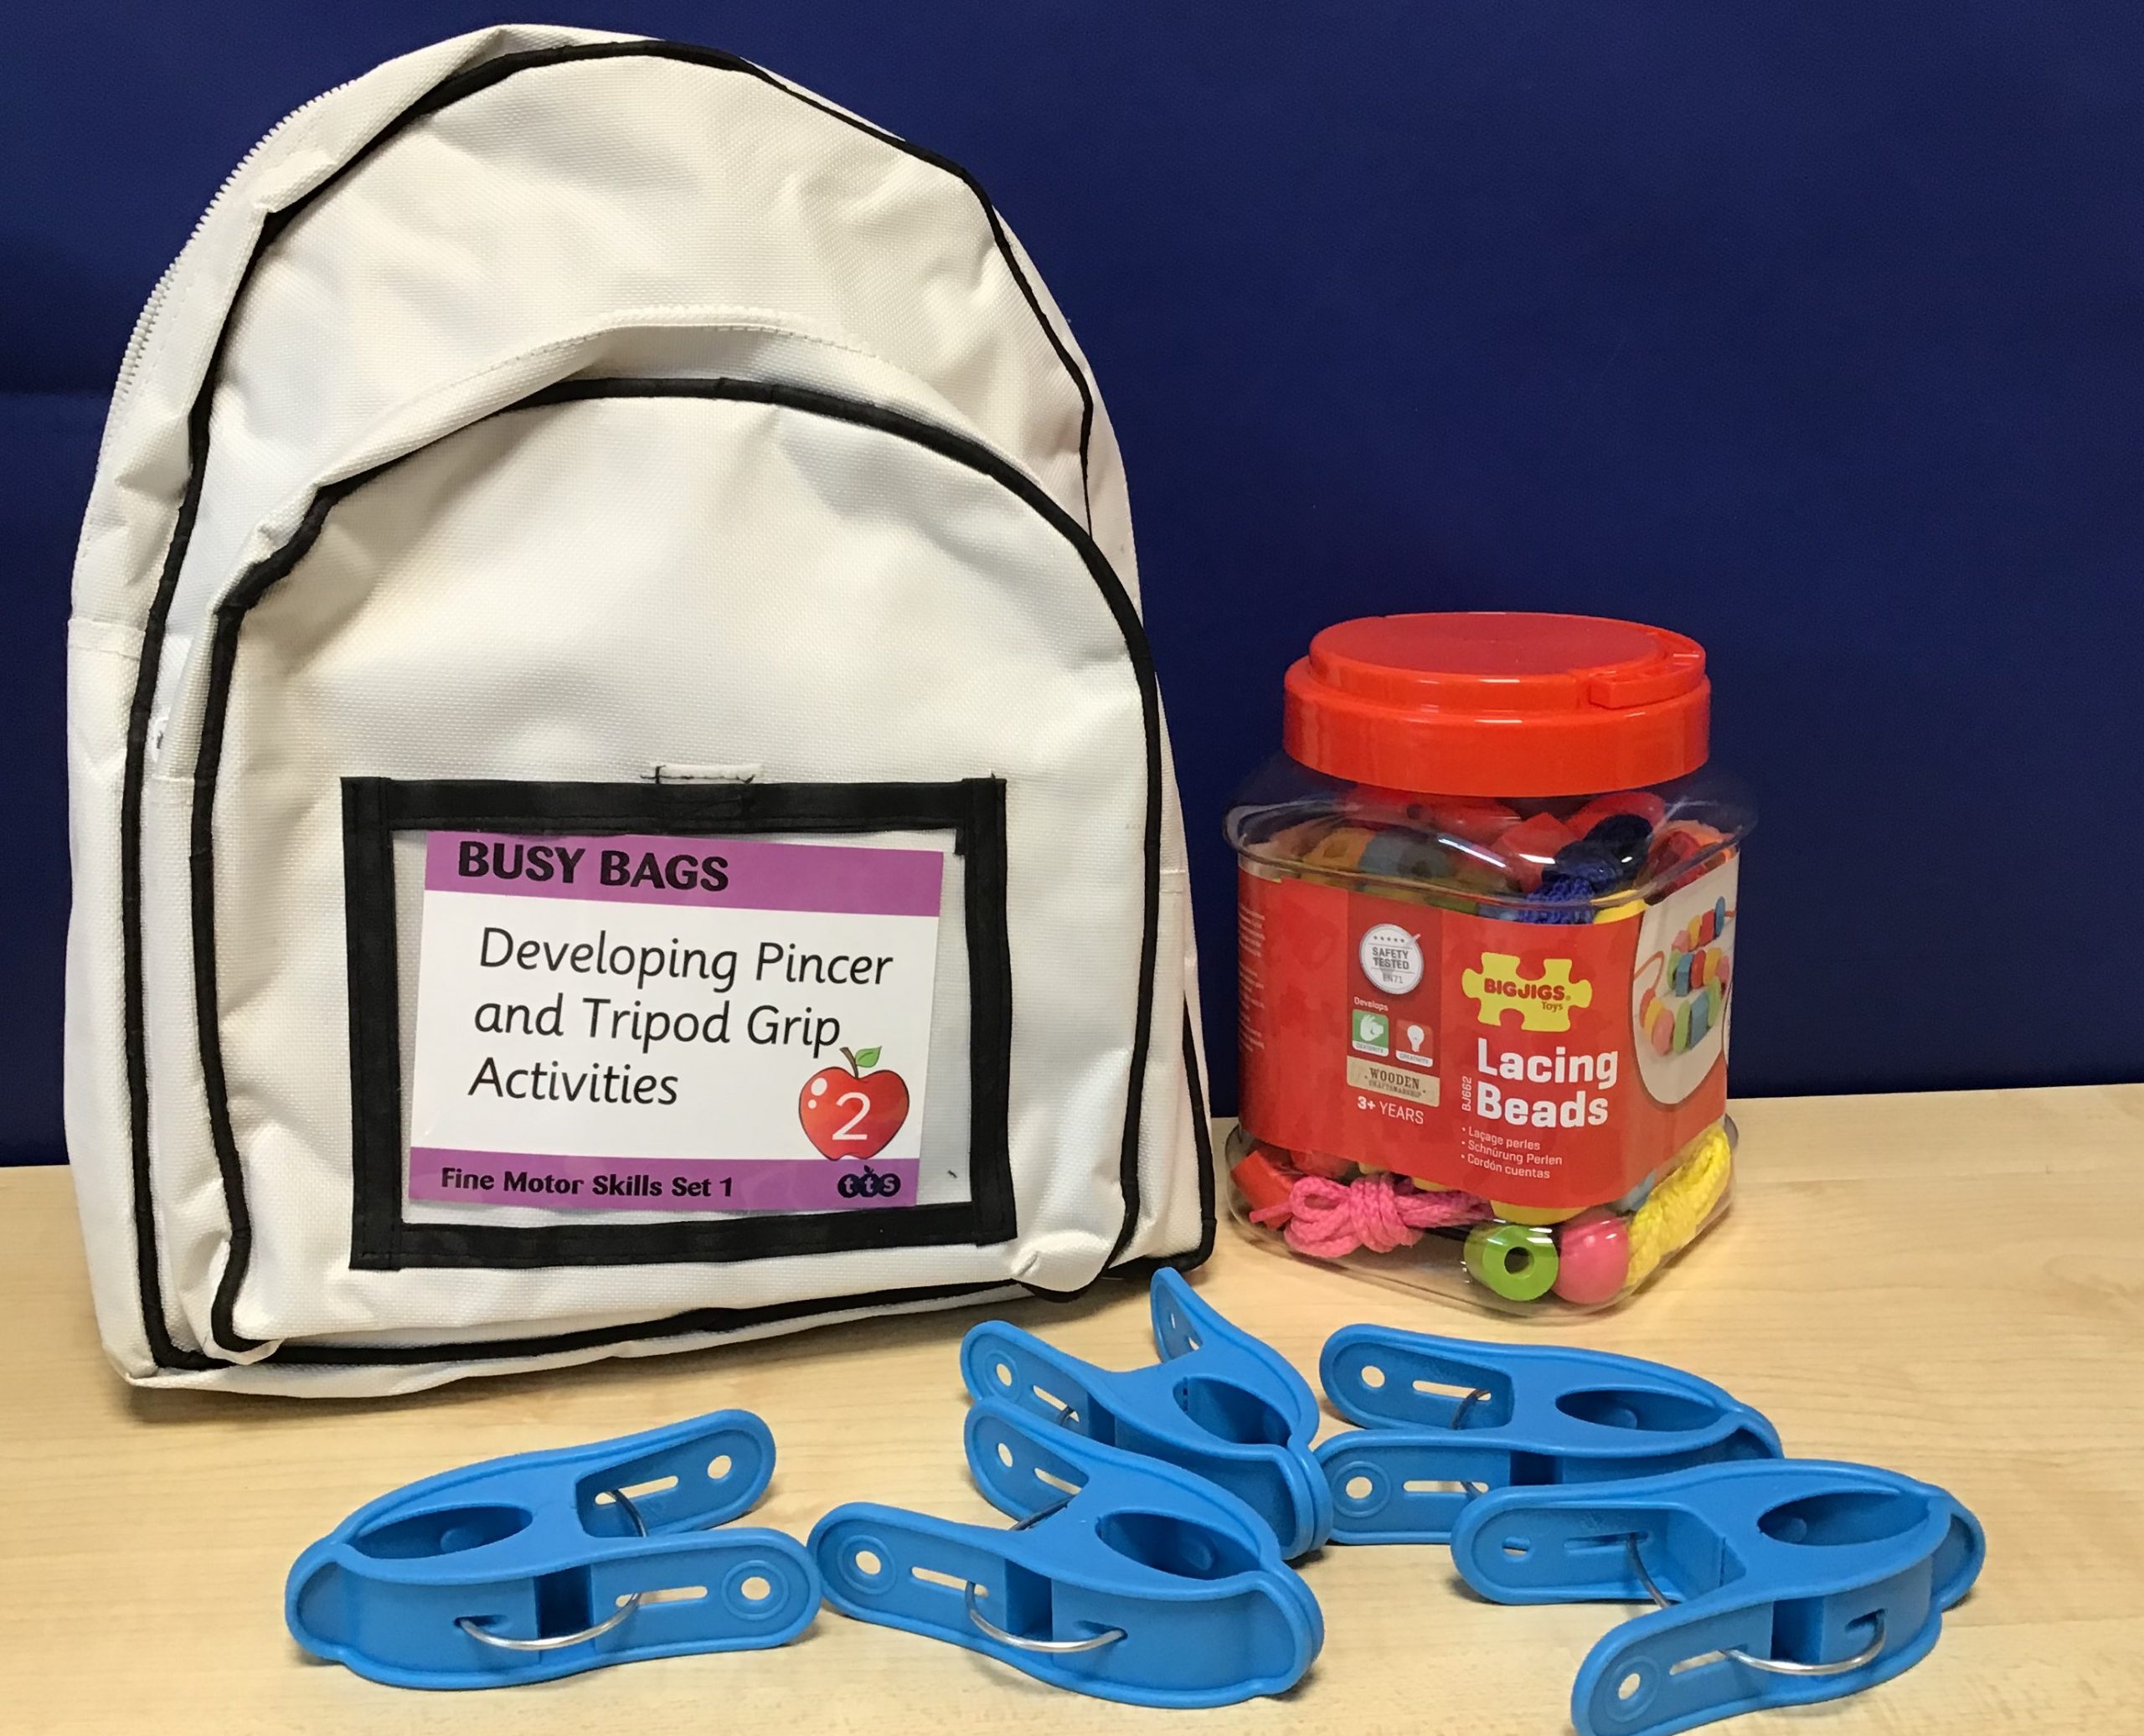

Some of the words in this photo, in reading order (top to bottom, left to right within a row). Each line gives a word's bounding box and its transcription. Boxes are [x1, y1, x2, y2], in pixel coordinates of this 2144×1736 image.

[458, 841, 585, 883] BUSY
[600, 850, 729, 892] BAGS
[480, 927, 737, 992] Developing
[756, 942, 894, 985] Pincer
[1372, 946, 1409, 960] SAFETY
[1372, 957, 1410, 970] TESTED
[1484, 978, 1565, 1001] BIGJIGS
[1353, 996, 1389, 1012] Develops
[1541, 1001, 1564, 1012] Toys
[474, 992, 564, 1037] and
[583, 997, 730, 1054] Tripod
[747, 1005, 840, 1059] Grip
[1477, 1037, 1618, 1090] Lacing
[467, 1057, 678, 1105] Activities
[1369, 1068, 1420, 1090] WOODEN
[1461, 1076, 1472, 1111] BJ662
[1477, 1080, 1608, 1128] Beads
[832, 1092, 871, 1141] 2
[1357, 1095, 1376, 1110] 3+
[1379, 1100, 1424, 1125] YEARS
[1469, 1126, 1503, 1146] Laçage
[1506, 1139, 1541, 1151] perles
[1467, 1154, 1502, 1172] Cordón
[1504, 1165, 1550, 1179] cuentas
[1526, 1154, 1563, 1166] Perlen
[441, 1167, 495, 1190] Fine
[503, 1171, 584, 1195] Motor
[592, 1174, 662, 1197] Skills
[671, 1176, 711, 1197] Set
[719, 1177, 733, 1198] 1
[842, 1175, 898, 1195] tts
